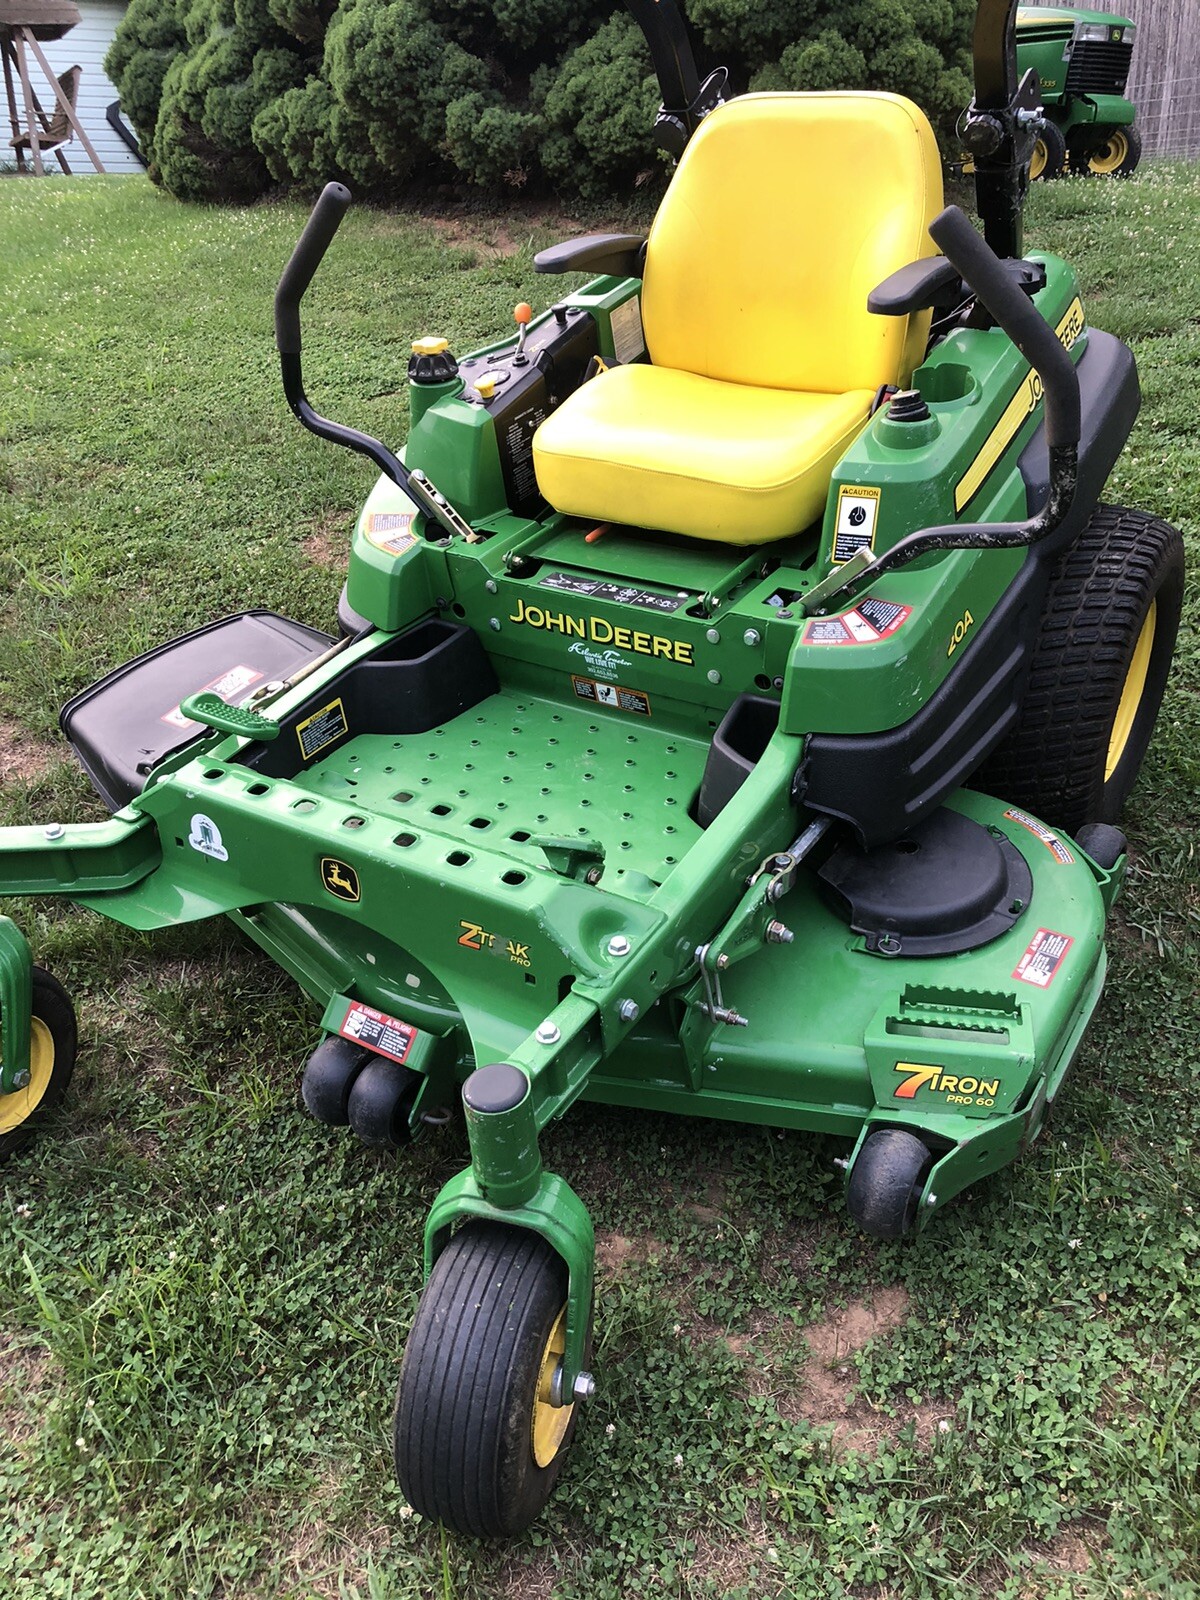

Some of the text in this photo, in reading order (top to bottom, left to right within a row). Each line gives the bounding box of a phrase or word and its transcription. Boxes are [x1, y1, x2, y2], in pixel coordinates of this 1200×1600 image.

[1028, 374, 1042, 409] JO
[848, 488, 879, 497] CAUTION
[509, 599, 694, 665] JOHN DEERE
[568, 642, 632, 666] Atlantic Tractor
[510, 955, 531, 968] PRO
[946, 1095, 995, 1108] PRO 60
